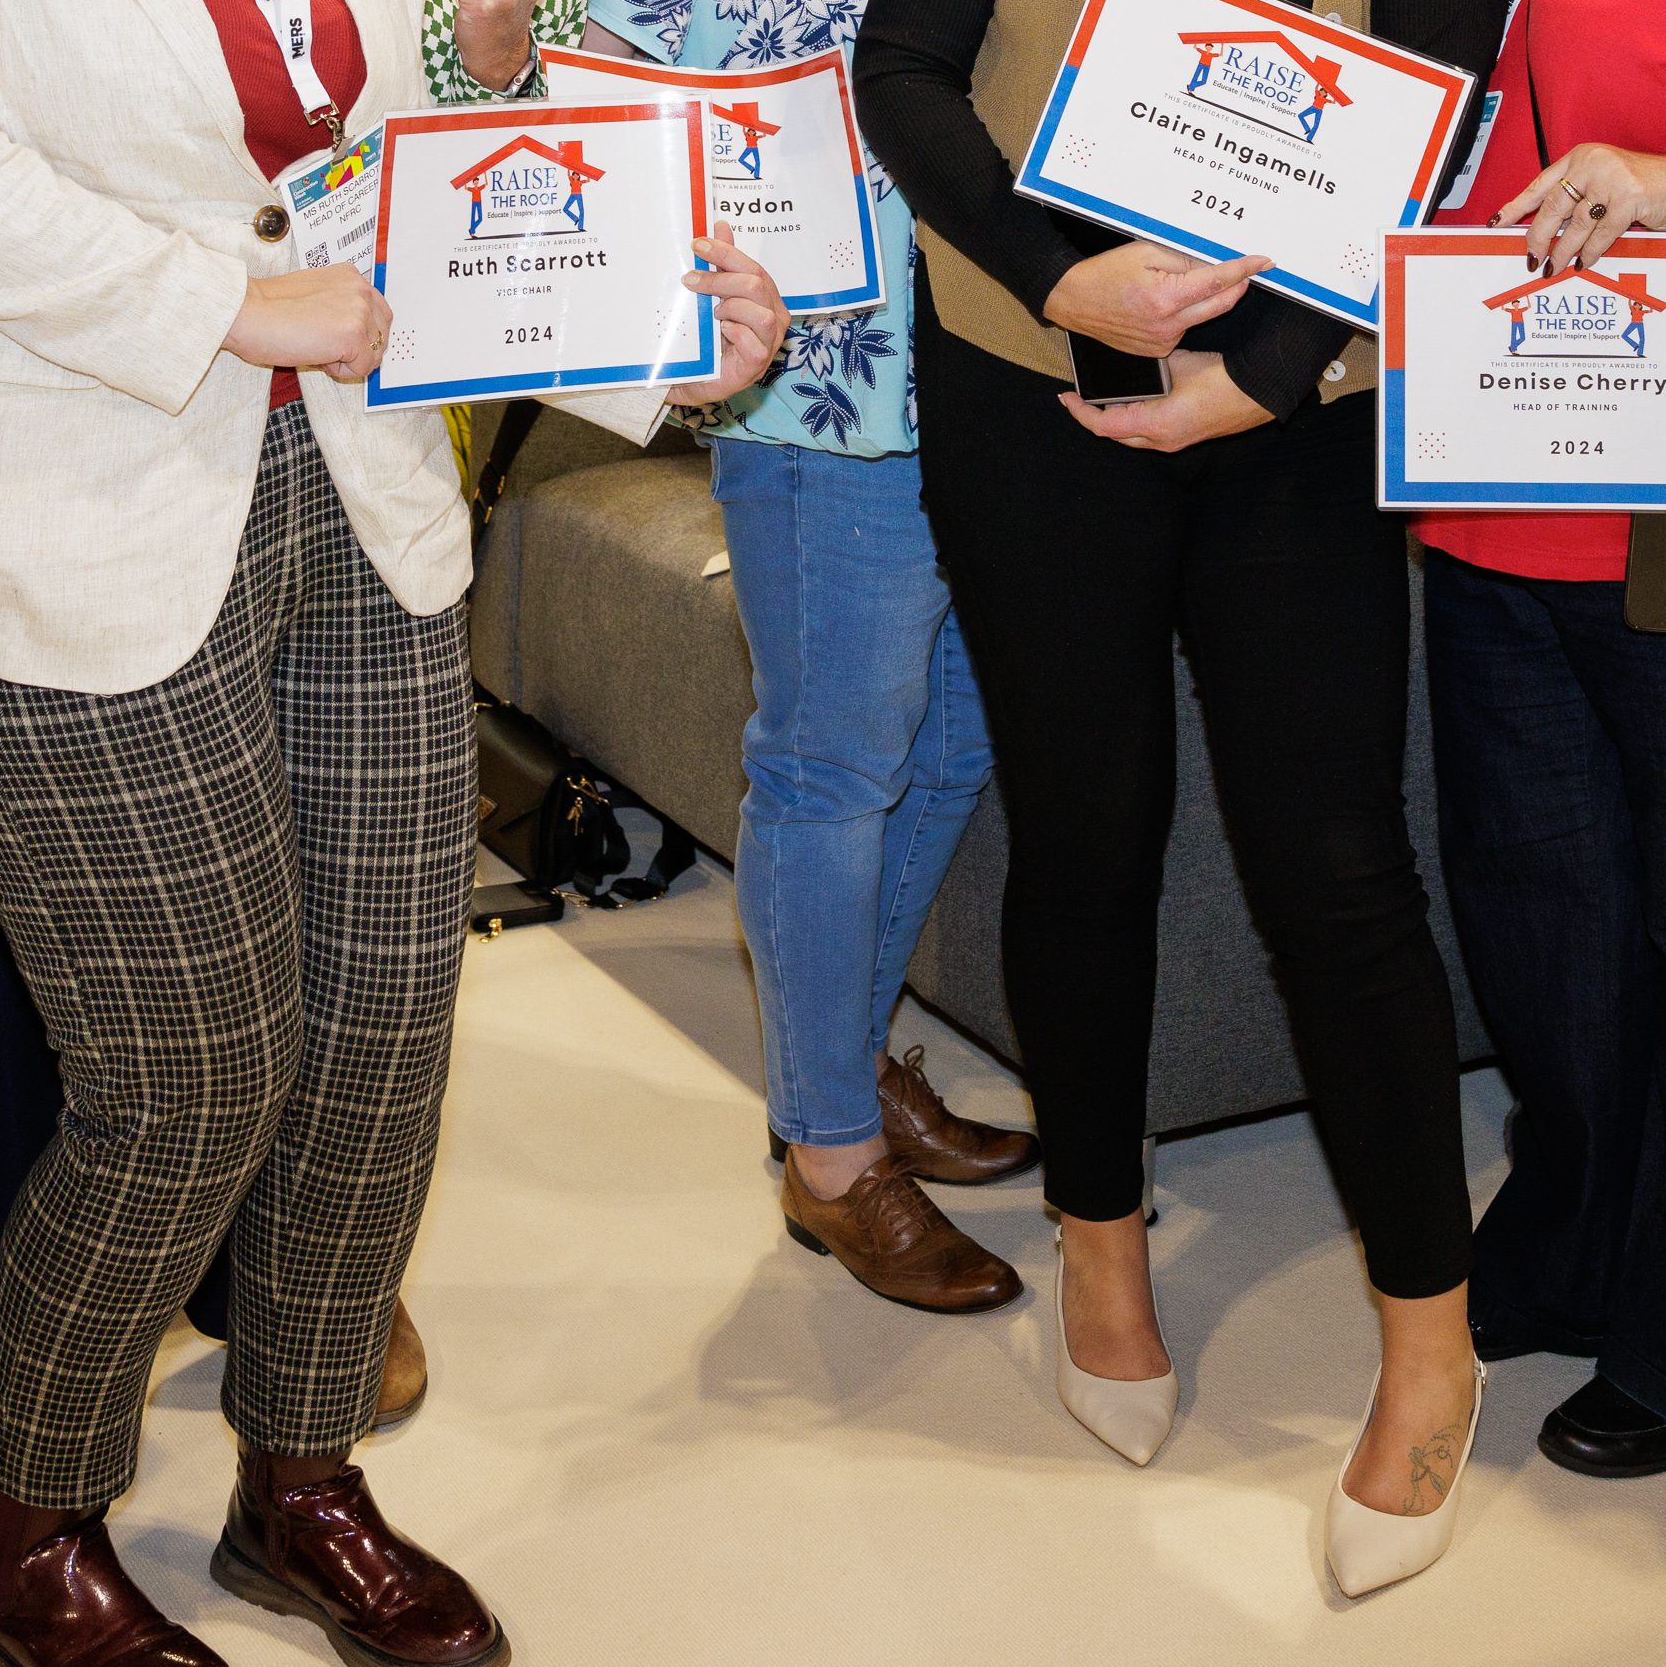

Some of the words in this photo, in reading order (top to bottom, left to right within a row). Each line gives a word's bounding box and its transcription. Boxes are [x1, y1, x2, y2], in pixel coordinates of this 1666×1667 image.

[289, 17, 305, 60] MERS
[1223, 45, 1306, 93] RAISE
[1222, 67, 1250, 90] THE
[1254, 80, 1298, 107] ROOF
[1130, 101, 1206, 142] Claire
[1214, 132, 1337, 195] Ingamells
[490, 167, 559, 192] RAISE
[1173, 146, 1205, 165] HEAD
[1209, 160, 1224, 172] OF
[1228, 167, 1280, 195] FUNDING
[303, 206, 317, 221] MS
[318, 191, 342, 212] RUTH
[343, 164, 380, 196] SCARROT
[491, 195, 516, 208] THE
[520, 192, 558, 207] ROOF
[309, 210, 333, 230] HEAD
[335, 202, 346, 214] OF
[339, 204, 362, 224] NFRC
[713, 196, 793, 216] aydon
[1190, 189, 1246, 221] 2024
[747, 224, 801, 233] MIDLANDS
[448, 256, 498, 278] Ruth
[506, 250, 607, 273] Scarrott
[522, 285, 553, 295] CHAIR
[1534, 295, 1618, 316] RAISE
[505, 325, 553, 344] 2024
[1536, 318, 1567, 330] THE
[1571, 318, 1616, 331] ROOF
[1531, 332, 1558, 340] Educate
[1564, 332, 1587, 341] Inspire
[1592, 333, 1620, 342] Support
[1479, 372, 1567, 390] Denise
[1576, 373, 1666, 395] Cherry
[1513, 403, 1541, 411] HEAD
[1546, 403, 1560, 411] OF
[1565, 403, 1618, 412] TRAINING
[1550, 440, 1605, 455] 2024
